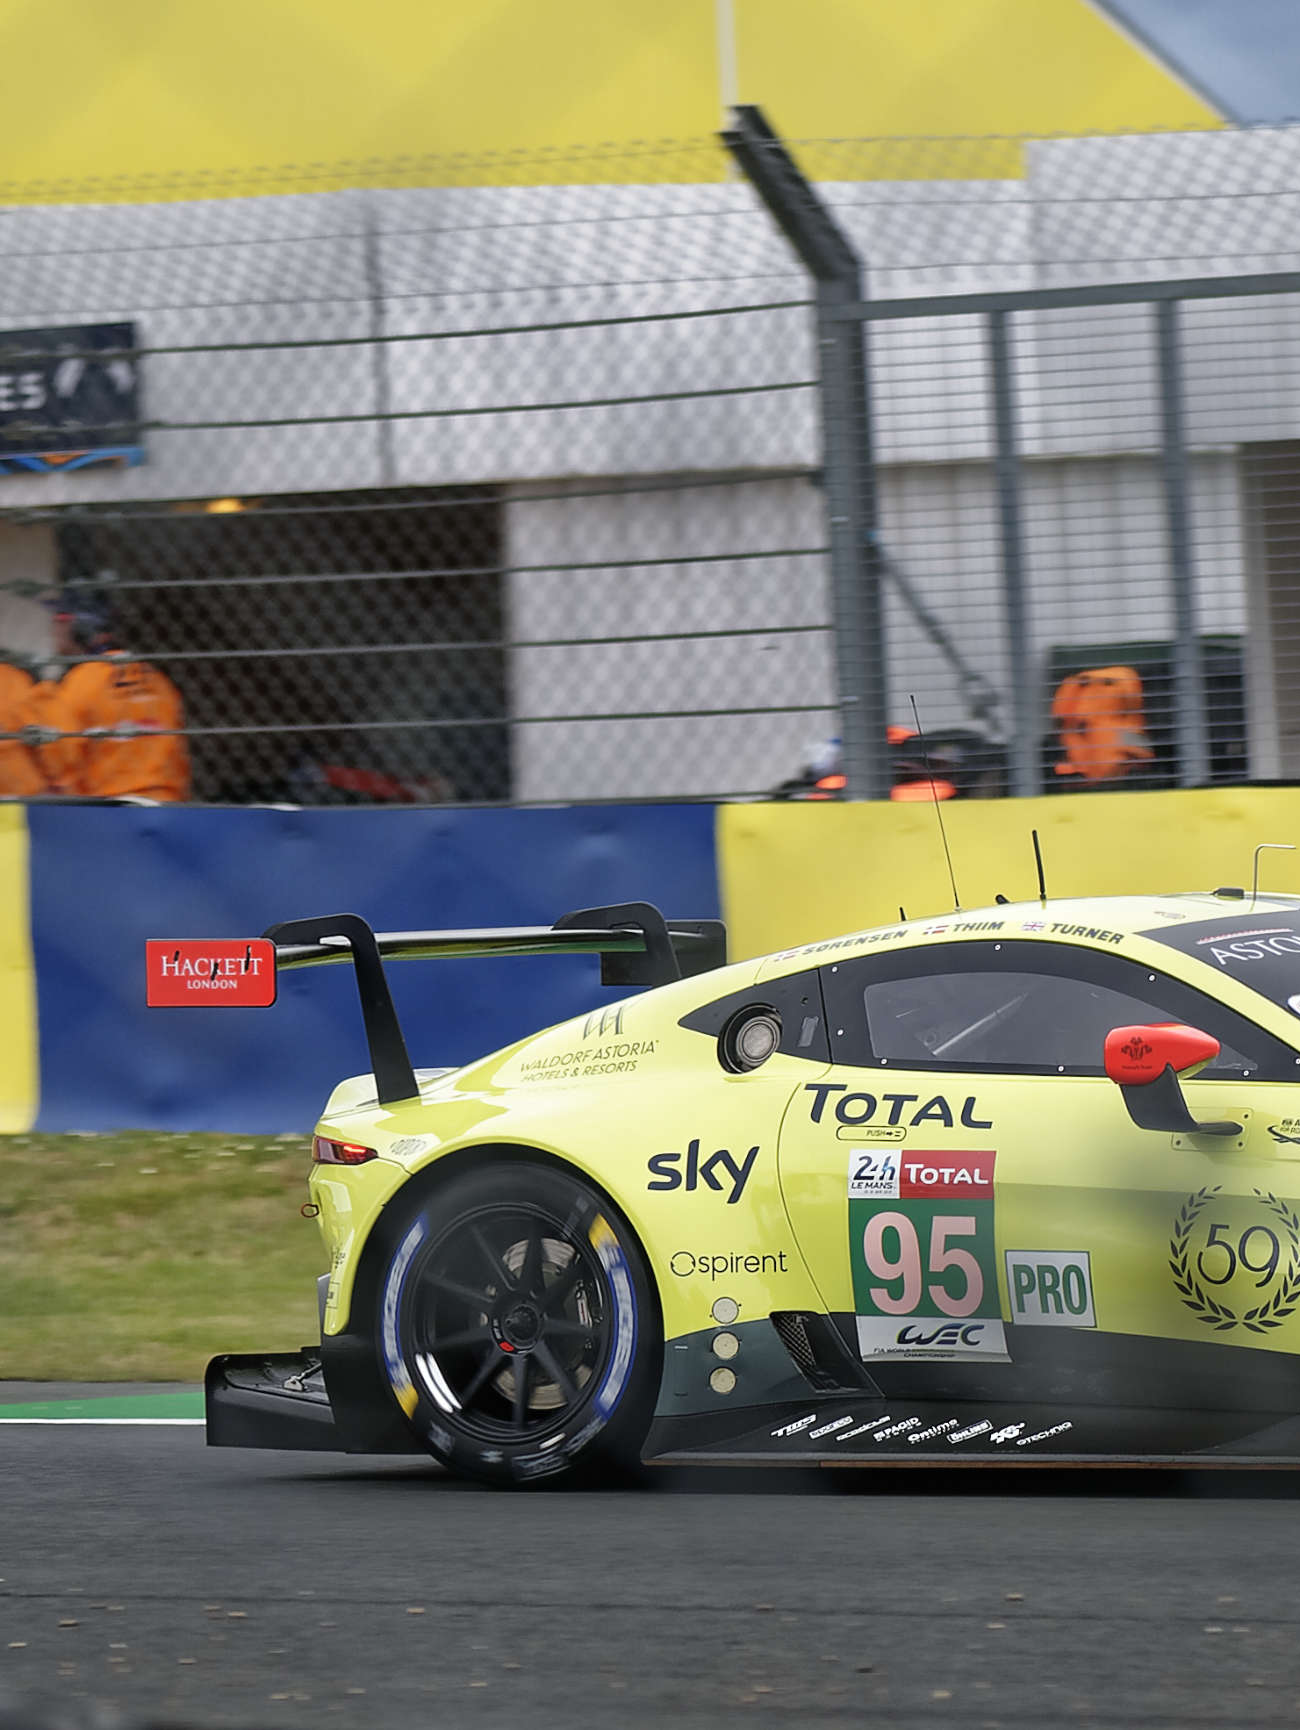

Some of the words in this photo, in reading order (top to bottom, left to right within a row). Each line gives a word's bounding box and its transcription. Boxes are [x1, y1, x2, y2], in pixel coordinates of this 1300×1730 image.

[953, 920, 1005, 932] THIIM
[1049, 922, 1126, 945] TURNER
[160, 955, 263, 977] HACKETT
[187, 979, 238, 990] LONDON
[520, 1049, 593, 1073] WALDORF
[592, 1040, 656, 1062] ASTORIA
[520, 1068, 570, 1083] HOTELS
[570, 1067, 579, 1078] &
[583, 1060, 639, 1076] RESORTS
[803, 1082, 995, 1130] TOTAL
[647, 1138, 761, 1205] sky
[851, 1181, 865, 1190] LE
[864, 1181, 894, 1190] MANS
[904, 1163, 990, 1185] TOTAL
[697, 1250, 788, 1281] spirent
[862, 1210, 985, 1318] 95
[1197, 1223, 1281, 1288] 59
[1012, 1263, 1088, 1316] PRO
[896, 1322, 985, 1346] WEC
